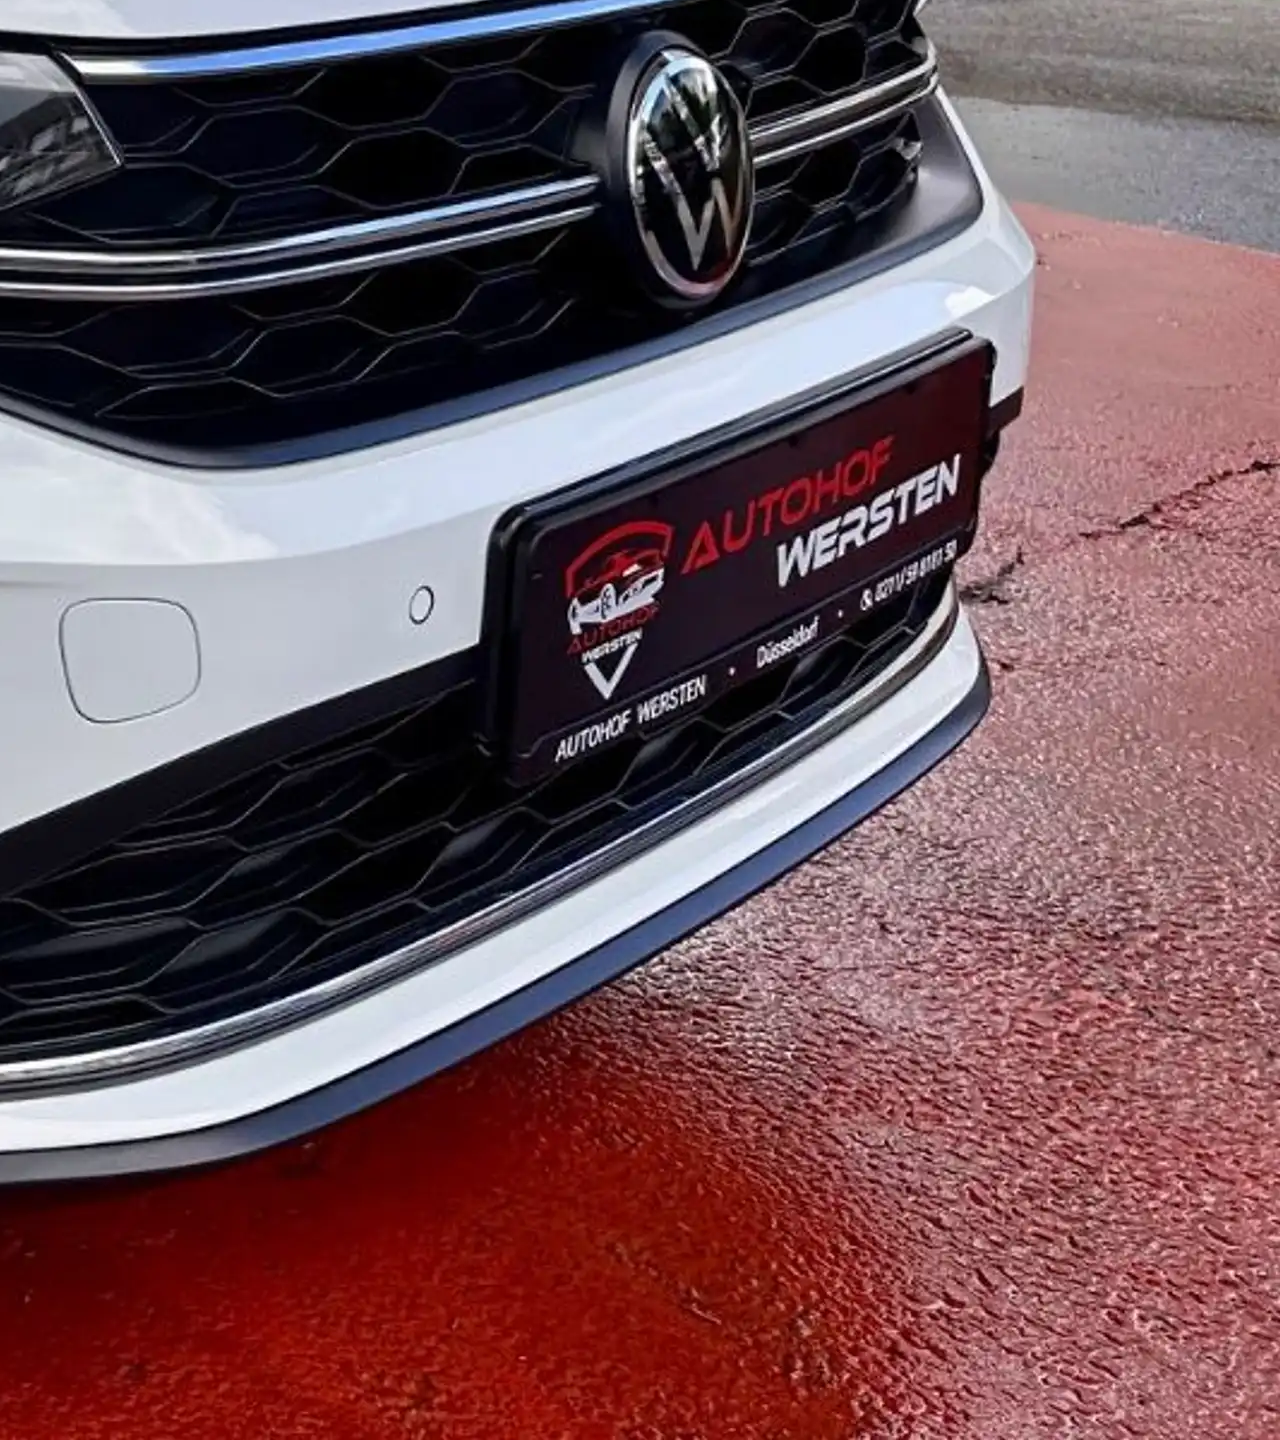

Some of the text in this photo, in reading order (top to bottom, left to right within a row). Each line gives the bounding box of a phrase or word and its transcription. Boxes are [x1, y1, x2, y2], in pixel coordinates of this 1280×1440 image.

[680, 435, 896, 574] AUTOHOF
[776, 453, 961, 588] WERSTEN
[555, 709, 633, 763] AUTOHOF
[636, 674, 708, 724] WERSTEN
[756, 615, 820, 668] Düsseldorf
[567, 601, 660, 654] AUTOHOF
